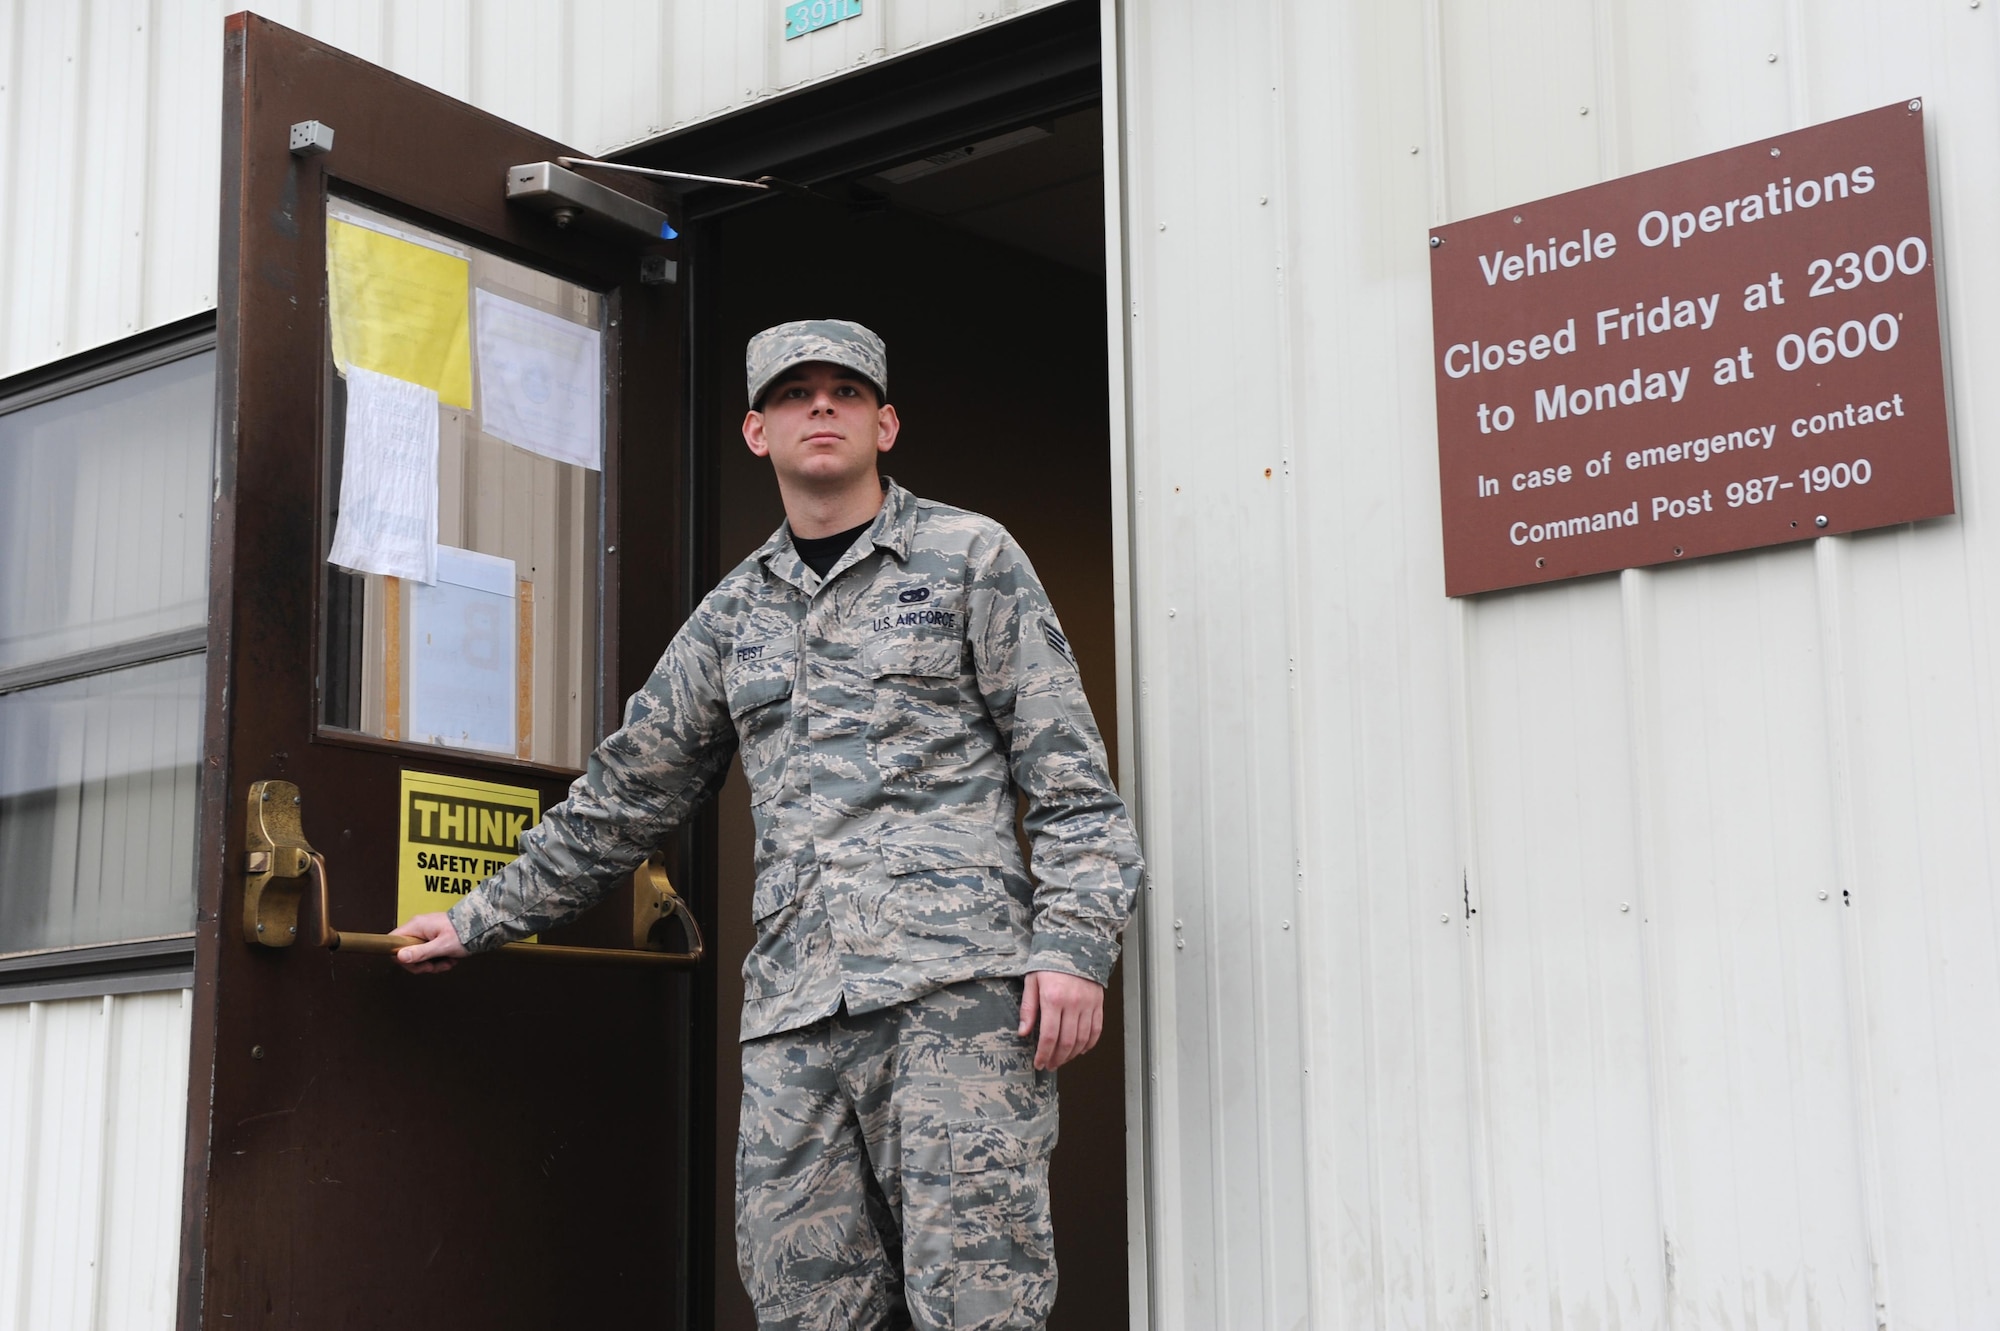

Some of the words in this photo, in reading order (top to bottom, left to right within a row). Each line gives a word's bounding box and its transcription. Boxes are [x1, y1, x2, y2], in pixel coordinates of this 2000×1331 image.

[1478, 228, 1617, 286] Vehicle
[1637, 165, 1876, 248] Operations
[1444, 318, 1577, 379] Closed
[1596, 293, 1721, 346] Friday
[1743, 271, 1785, 312] at
[1807, 236, 1928, 298] 2300
[1476, 403, 1515, 434] to
[1534, 366, 1691, 424] Monday
[1713, 346, 1755, 386] at
[1775, 312, 1899, 372] 0600
[1478, 475, 1500, 498] In
[1511, 464, 1573, 492] case
[1585, 450, 1612, 478] of
[1625, 424, 1777, 470] emergency
[1791, 393, 1905, 438] contact
[1509, 501, 1639, 546] Command
[1651, 489, 1713, 522] Post
[1725, 458, 1872, 508] 987-1900
[736, 645, 766, 663] FEIST
[873, 616, 893, 632] U.S.
[895, 612, 918, 627] AIR
[919, 610, 955, 628] FORCE
[413, 799, 528, 848] THINK
[417, 851, 479, 875] SAFETY
[424, 875, 472, 896] WEAR
